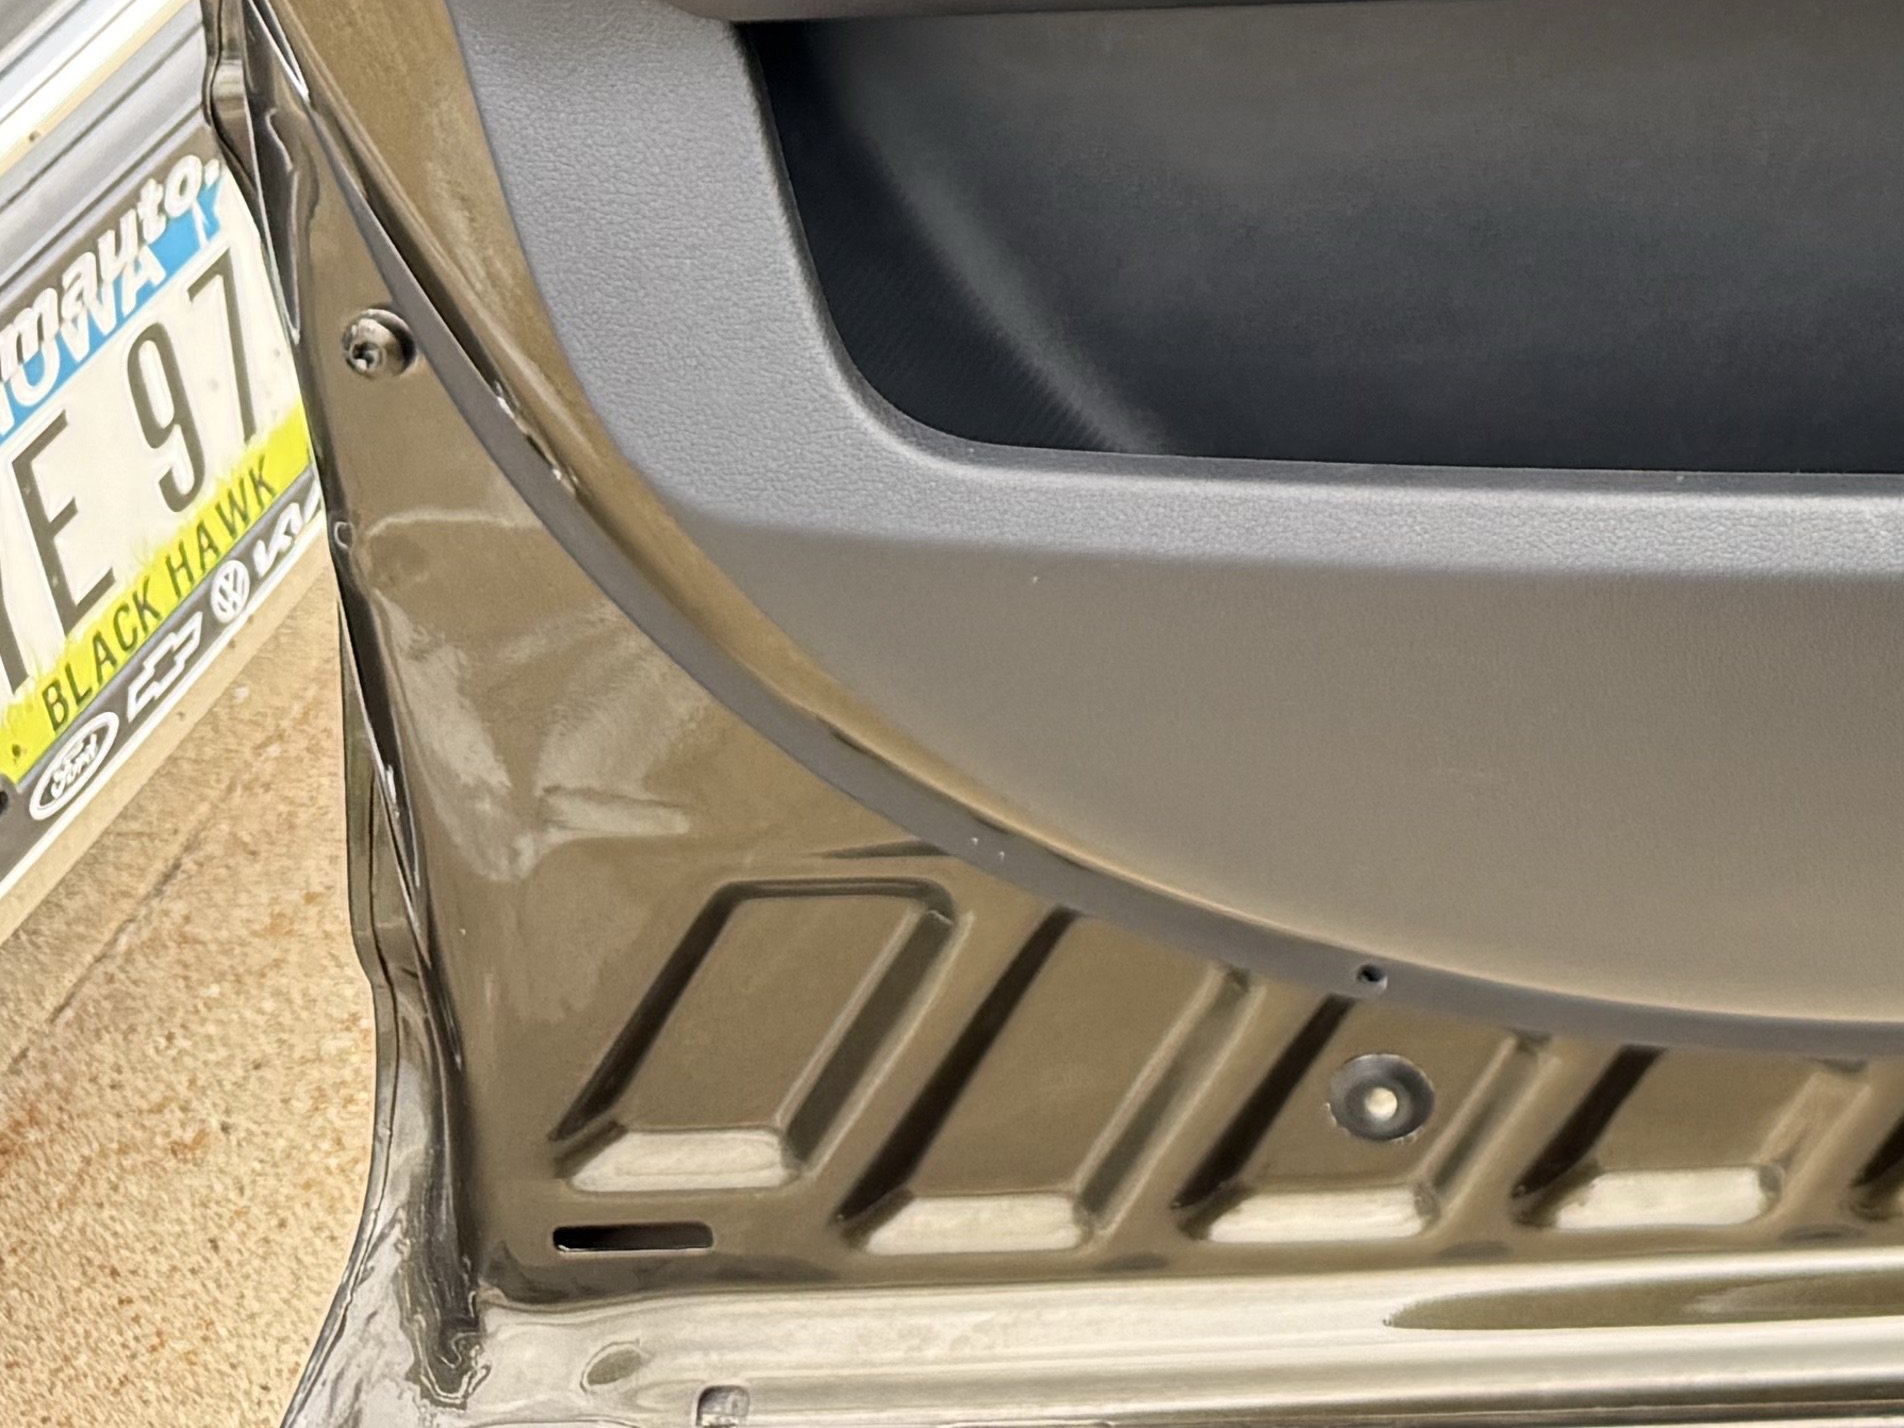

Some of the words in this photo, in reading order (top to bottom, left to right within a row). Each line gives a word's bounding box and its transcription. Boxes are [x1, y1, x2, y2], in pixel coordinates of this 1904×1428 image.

[126, 244, 258, 513] 97
[41, 575, 162, 733] BLACK
[164, 453, 278, 603] HAWK
